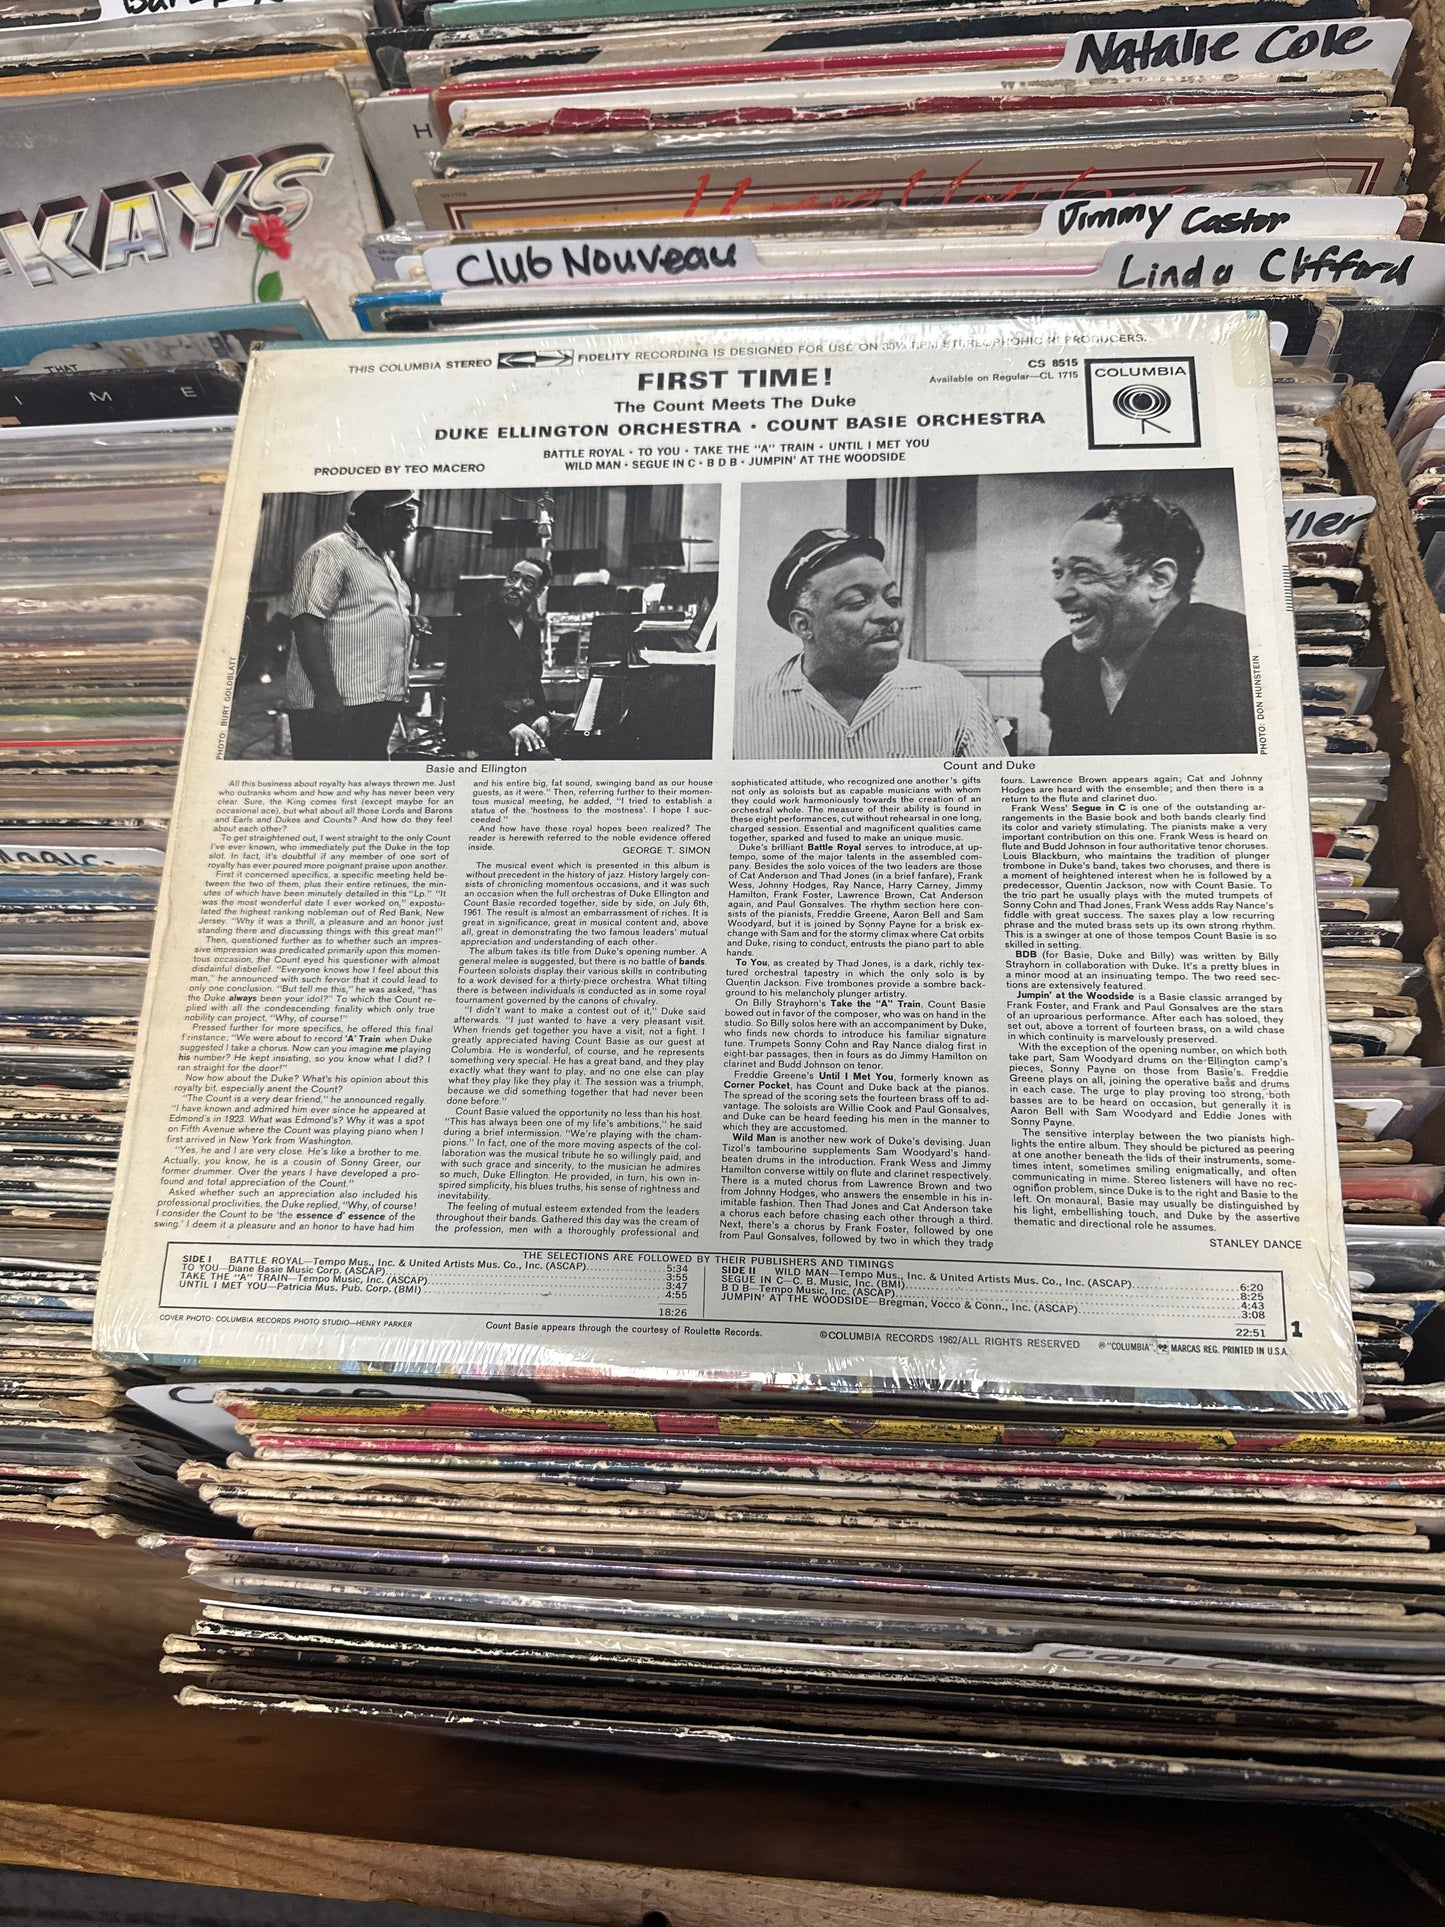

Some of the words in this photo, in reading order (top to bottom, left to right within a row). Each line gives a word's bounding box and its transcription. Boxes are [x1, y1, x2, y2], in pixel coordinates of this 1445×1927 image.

[1075, 29, 1240, 74] Natalie
[1255, 24, 1373, 64] Cole
[1181, 206, 1291, 236] Castor
[456, 245, 553, 287] Club
[563, 243, 737, 278] Nouveau
[1118, 253, 1234, 290] Linda
[577, 351, 632, 363] FIDELITY
[635, 348, 708, 360] RECORDING
[713, 347, 725, 357] IS
[729, 345, 794, 358] DESIGNED
[797, 344, 827, 355] FOR
[827, 343, 855, 355] USE
[858, 341, 880, 353] ON
[348, 364, 375, 374] THIS
[378, 361, 441, 373] COLUMBIA
[444, 358, 493, 370] STEREO
[1027, 359, 1046, 368] CS
[1051, 356, 1080, 368] 8515
[929, 374, 973, 384] Available
[1057, 370, 1079, 379] 1715
[1094, 366, 1188, 378] COLUMBIA
[638, 370, 729, 391] FIRST
[737, 367, 831, 388] TIME!
[613, 400, 646, 413] The
[652, 400, 704, 412] Count
[712, 398, 765, 411] Meets
[770, 396, 803, 409] The
[811, 394, 856, 408] Duke
[435, 427, 488, 440] DUKE
[497, 424, 608, 439] ELLINGTON
[617, 420, 741, 436] ORCHESTRA
[766, 417, 839, 432] COUNT
[846, 415, 906, 429] BASIE
[916, 411, 1045, 427] ORCHESTRA
[543, 449, 585, 459] BATTLE
[588, 448, 625, 458] ROYAL
[637, 447, 653, 456] TO
[656, 446, 680, 456] YOU
[693, 445, 723, 455] TAKE
[727, 444, 749, 454] THE
[779, 442, 814, 452] TRAIN
[828, 440, 863, 451] UNTIL
[867, 440, 871, 450] I
[876, 439, 901, 449] MET
[905, 438, 930, 448] YOU
[564, 461, 593, 471] WILD
[595, 460, 621, 470] MAN
[632, 459, 669, 469] SEGUE
[672, 459, 684, 468] IN
[687, 458, 695, 468] C
[706, 458, 714, 467] B
[718, 458, 726, 467] D
[729, 457, 737, 467] B
[799, 455, 815, 464] AT
[817, 454, 841, 464] THE
[844, 452, 906, 463] WOODSIDE
[314, 465, 381, 476] PRODUCED
[384, 465, 401, 474] BY
[404, 464, 429, 474] TEO
[432, 463, 485, 473] MACERO
[1251, 655, 1262, 699] HUNSTEIN
[1256, 701, 1265, 720] DON
[425, 764, 455, 773] Basie
[458, 763, 478, 773] and
[481, 763, 527, 775] Ellington
[943, 760, 978, 770] Count
[982, 760, 1003, 770] and
[1006, 760, 1036, 770] Duke
[228, 779, 240, 787] All
[241, 779, 256, 787] this
[293, 779, 317, 788] about
[318, 779, 346, 789] royalty
[347, 779, 362, 787] has
[363, 779, 391, 788] always
[392, 779, 420, 787] thrown
[438, 779, 456, 787] Just
[999, 776, 1025, 784] fours.
[1030, 776, 1073, 784] Lawrence
[1078, 775, 1107, 783] Brown
[1111, 776, 1149, 785] appears
[1153, 774, 1182, 784] again;
[1186, 774, 1204, 782] Cat
[1208, 774, 1226, 782] and
[1230, 773, 1263, 786] Johnny
[622, 846, 663, 854] GEORGE
[666, 846, 675, 854] T.
[678, 846, 711, 855] SIMON
[1209, 1238, 1259, 1248] STANLEY
[1263, 1239, 1302, 1249] DANCE
[182, 1254, 205, 1263] SIDE
[207, 1255, 212, 1263] I
[522, 1250, 543, 1259] THE
[546, 1251, 609, 1261] SELECTIONS
[612, 1252, 634, 1262] ARE
[638, 1253, 692, 1263] FOLLOWED
[696, 1254, 711, 1263] BY
[714, 1255, 746, 1264] THEIR
[750, 1256, 817, 1267] PUBLISHERS
[820, 1258, 844, 1267] AND
[847, 1259, 894, 1269] TIMINGS
[666, 1264, 688, 1273] 5:34
[721, 1265, 745, 1274] SIDE
[748, 1266, 756, 1274] II
[666, 1272, 688, 1282] 3:55
[665, 1281, 688, 1290] 3:47
[1240, 1282, 1264, 1292] 6:20
[665, 1290, 688, 1299] 4:55
[1240, 1292, 1264, 1301] 8:25
[1241, 1301, 1264, 1310] 4:43
[659, 1307, 687, 1317] 18:26
[1241, 1310, 1265, 1319] 3:08
[485, 1320, 511, 1330] Count
[514, 1321, 539, 1331] Basie
[541, 1324, 576, 1333] appears
[578, 1322, 611, 1334] through
[614, 1323, 628, 1333] the
[631, 1325, 669, 1336] courtesy
[671, 1325, 681, 1334] of
[683, 1325, 721, 1336] Roulette
[724, 1327, 763, 1337] Records.
[1235, 1328, 1266, 1337] 22:51
[1291, 1321, 1303, 1337] 1
[1170, 1344, 1202, 1355] MARCAS
[1203, 1344, 1220, 1354] REG.
[1222, 1345, 1254, 1355] PRINTED
[1256, 1346, 1265, 1355] IN
[1267, 1346, 1289, 1356] U.S.A.
